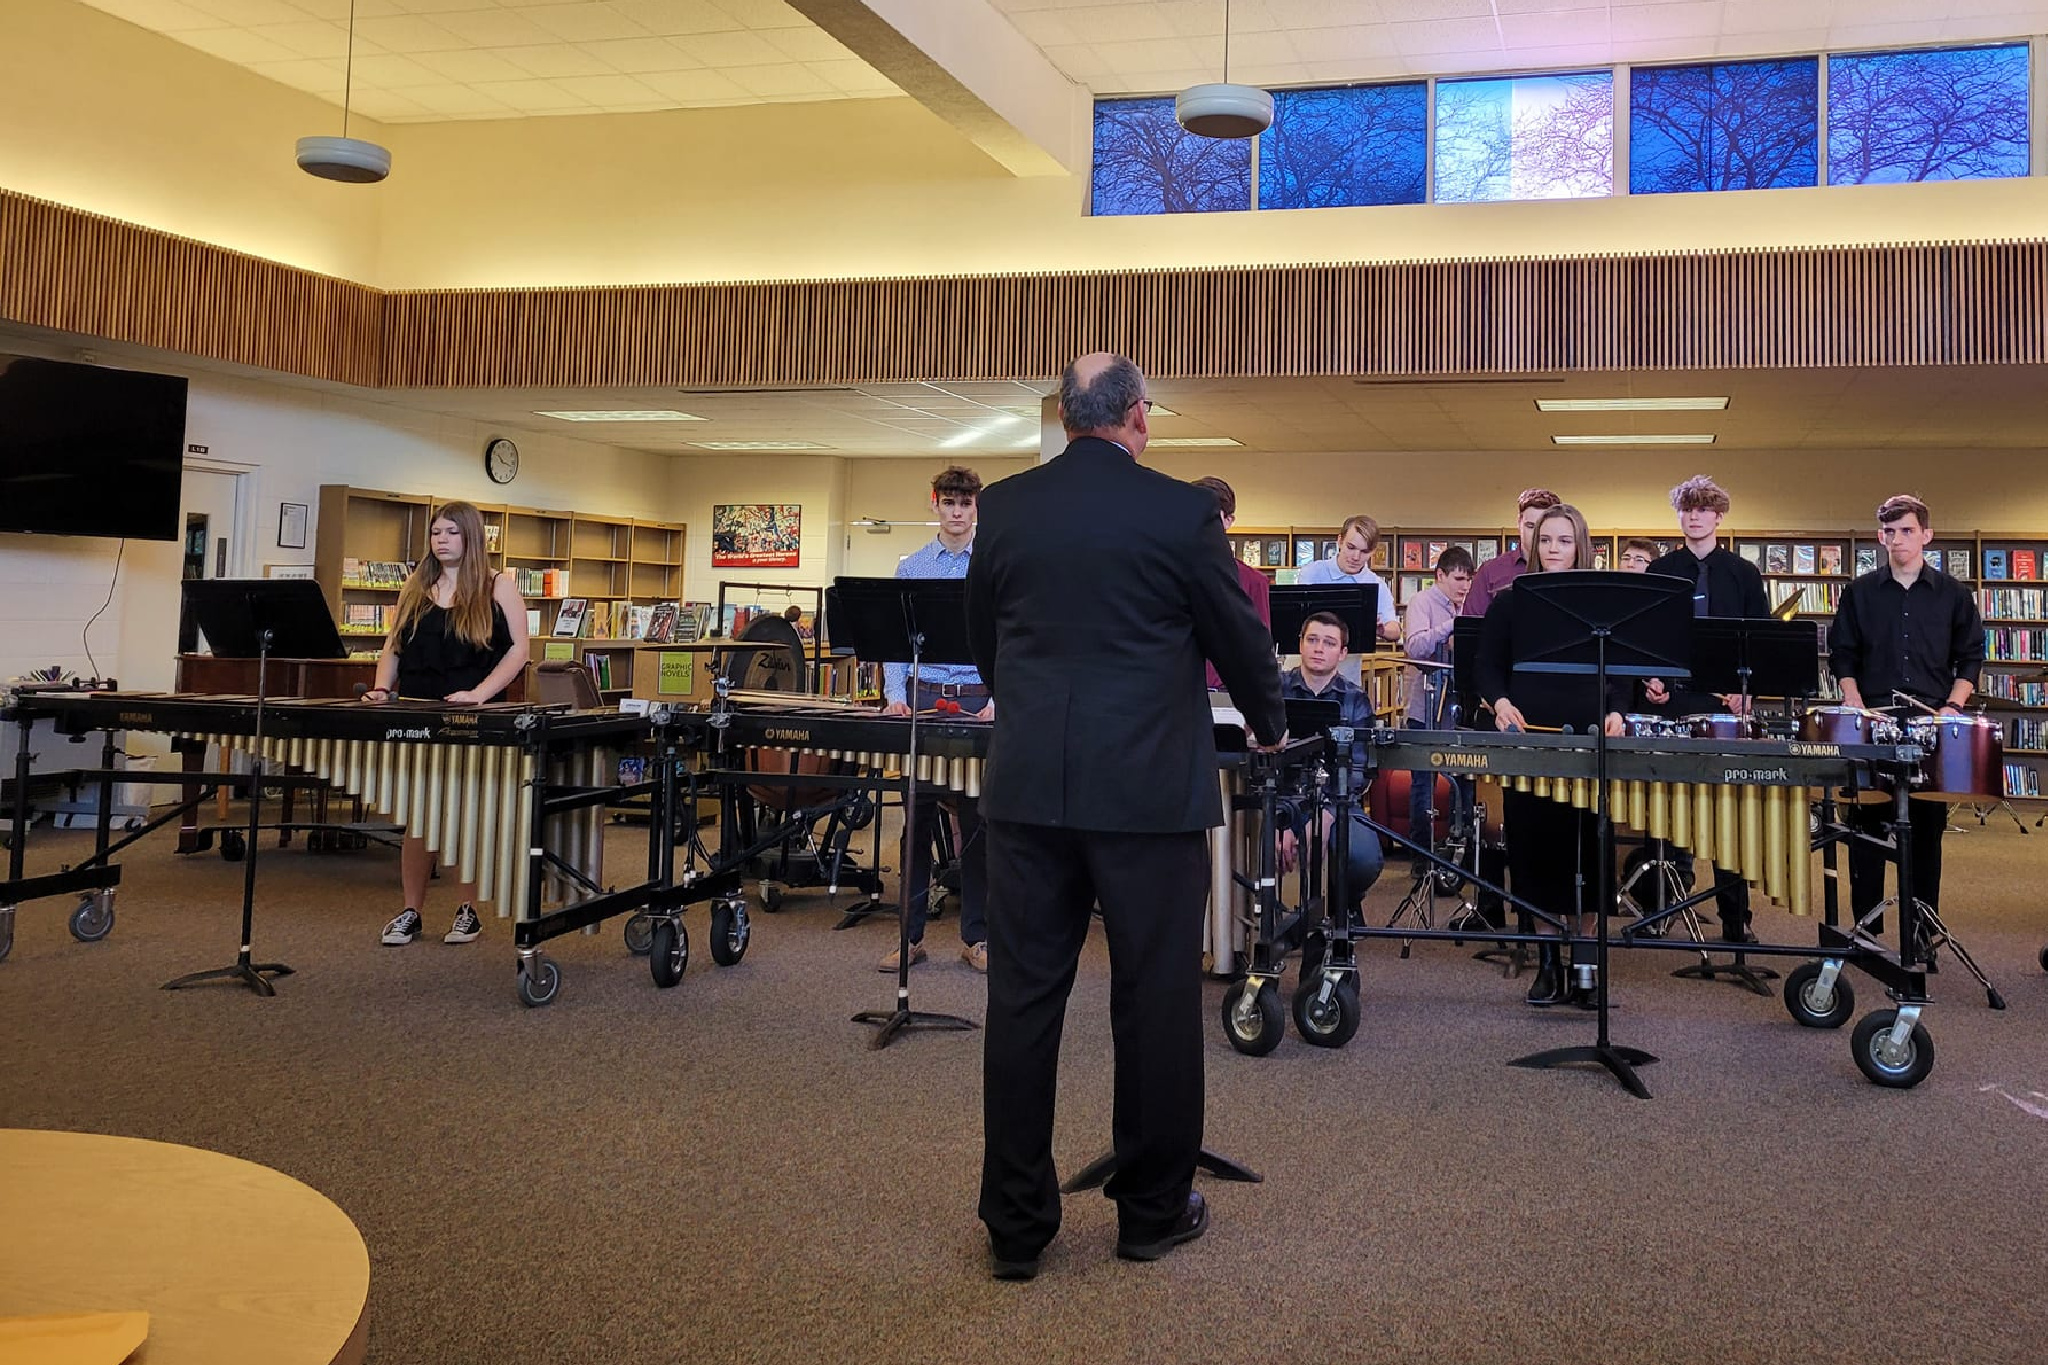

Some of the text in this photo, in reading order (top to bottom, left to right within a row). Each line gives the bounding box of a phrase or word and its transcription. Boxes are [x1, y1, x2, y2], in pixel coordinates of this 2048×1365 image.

[714, 552, 727, 560] The
[750, 551, 775, 559] Greatest
[661, 662, 692, 671] GRAPHIC
[775, 728, 810, 741] YAMAHA
[1801, 744, 1841, 756] YAMAHA
[1444, 753, 1489, 768] YAMAHA
